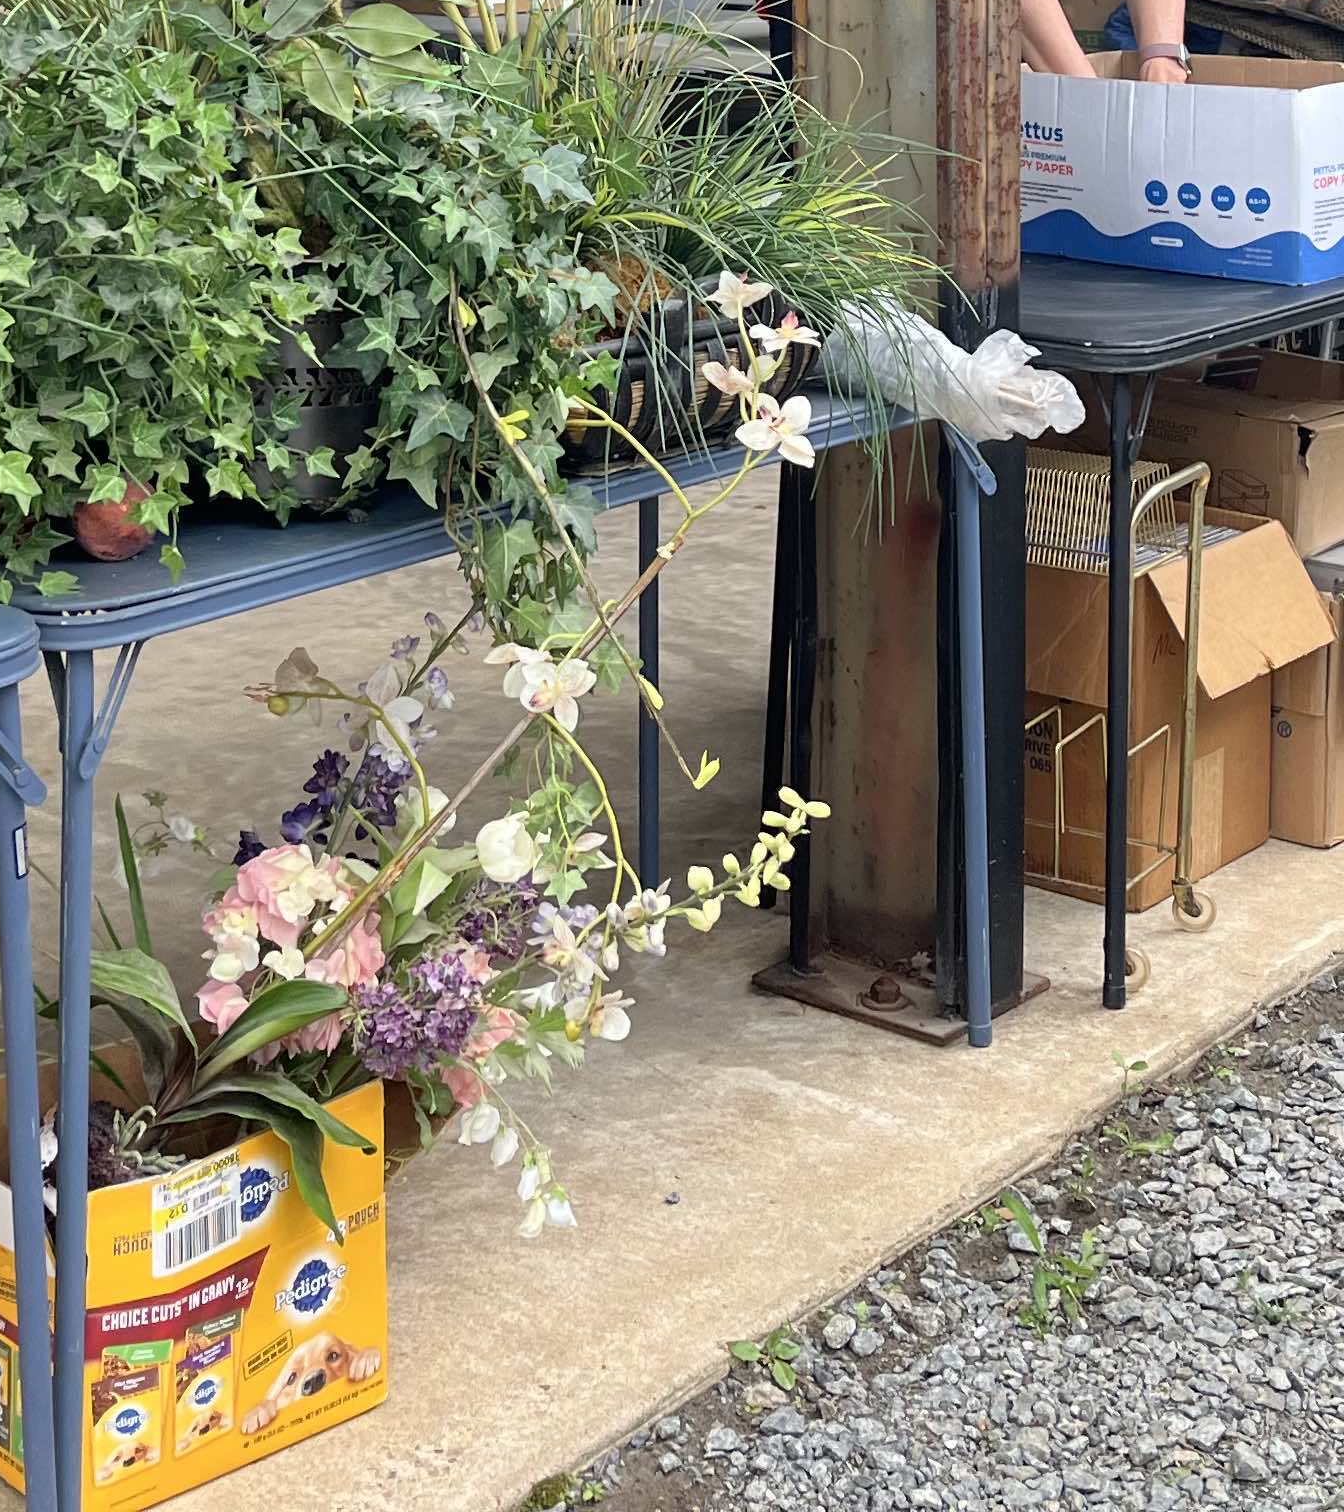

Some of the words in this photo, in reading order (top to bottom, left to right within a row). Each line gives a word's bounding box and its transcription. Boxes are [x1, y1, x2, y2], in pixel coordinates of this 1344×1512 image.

[1020, 121, 1064, 142] ttus
[1035, 160, 1074, 176] PAPER
[1312, 175, 1339, 190] COPY
[1024, 738, 1051, 757] RIVE
[240, 1169, 289, 1207] Pedig
[348, 1201, 380, 1228] POUCH
[113, 1237, 152, 1257] OUCH
[274, 1263, 348, 1312] Pedigree
[101, 1307, 149, 1332] CHOICE
[188, 1288, 201, 1311] IN
[201, 1274, 235, 1305] GRAVY
[235, 1277, 249, 1294] 12
